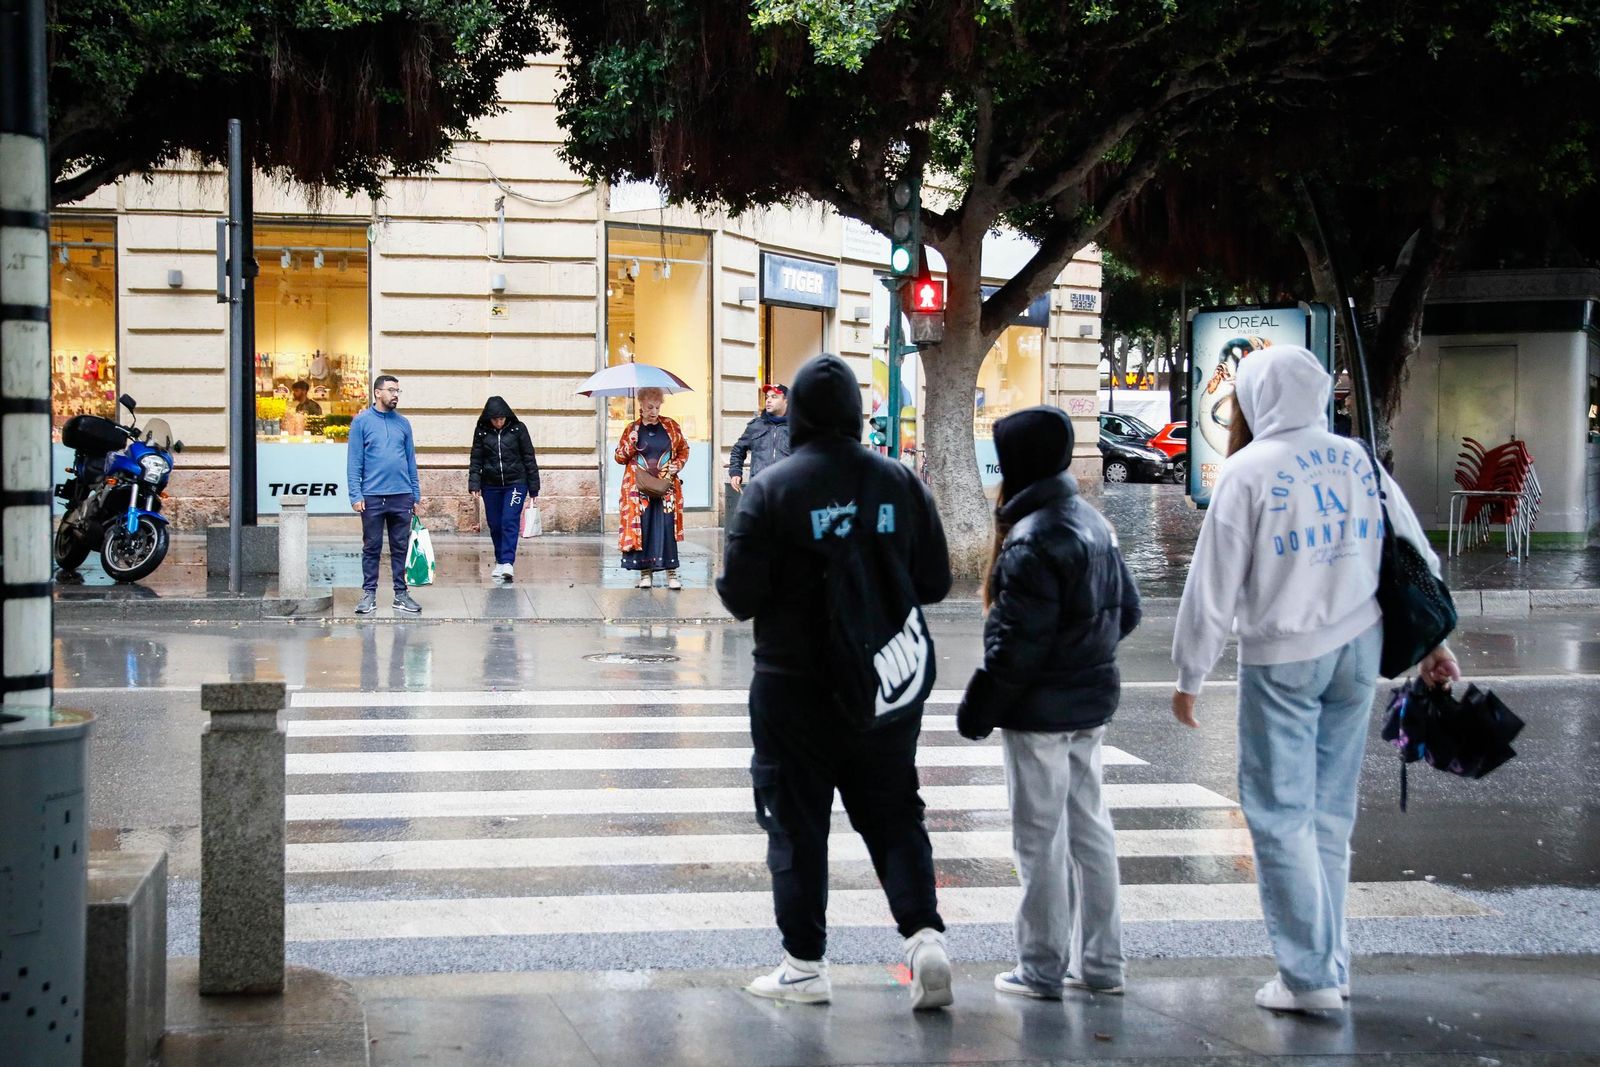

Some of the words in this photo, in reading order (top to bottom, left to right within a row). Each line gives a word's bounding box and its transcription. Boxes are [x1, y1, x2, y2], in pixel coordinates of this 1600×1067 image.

[781, 266, 823, 295] TIGER
[268, 483, 339, 497] TIGER
[1269, 471, 1295, 512] LOS
[1310, 482, 1349, 517] LA
[1273, 518, 1385, 556] DOWNTWN
